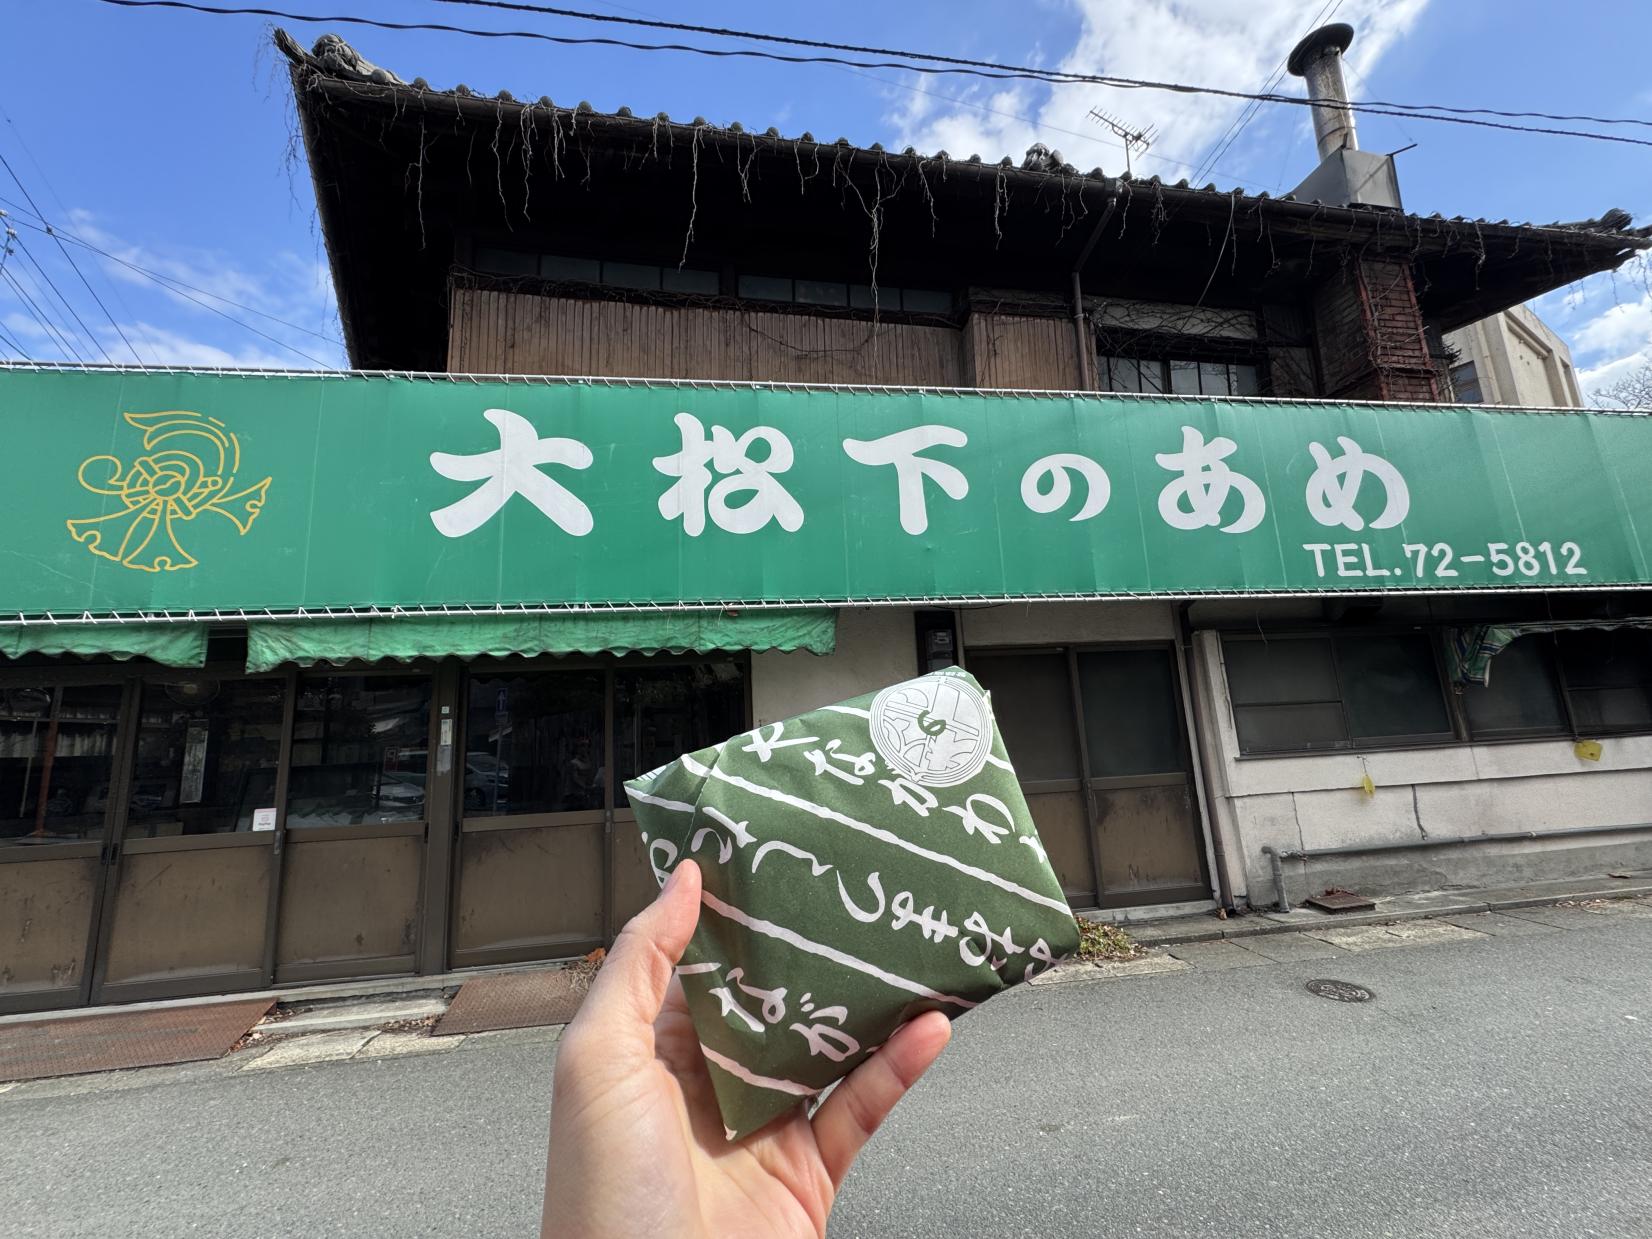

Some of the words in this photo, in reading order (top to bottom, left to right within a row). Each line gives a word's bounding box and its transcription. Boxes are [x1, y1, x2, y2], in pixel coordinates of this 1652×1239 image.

[430, 408, 1411, 537] 大松下のあめ
